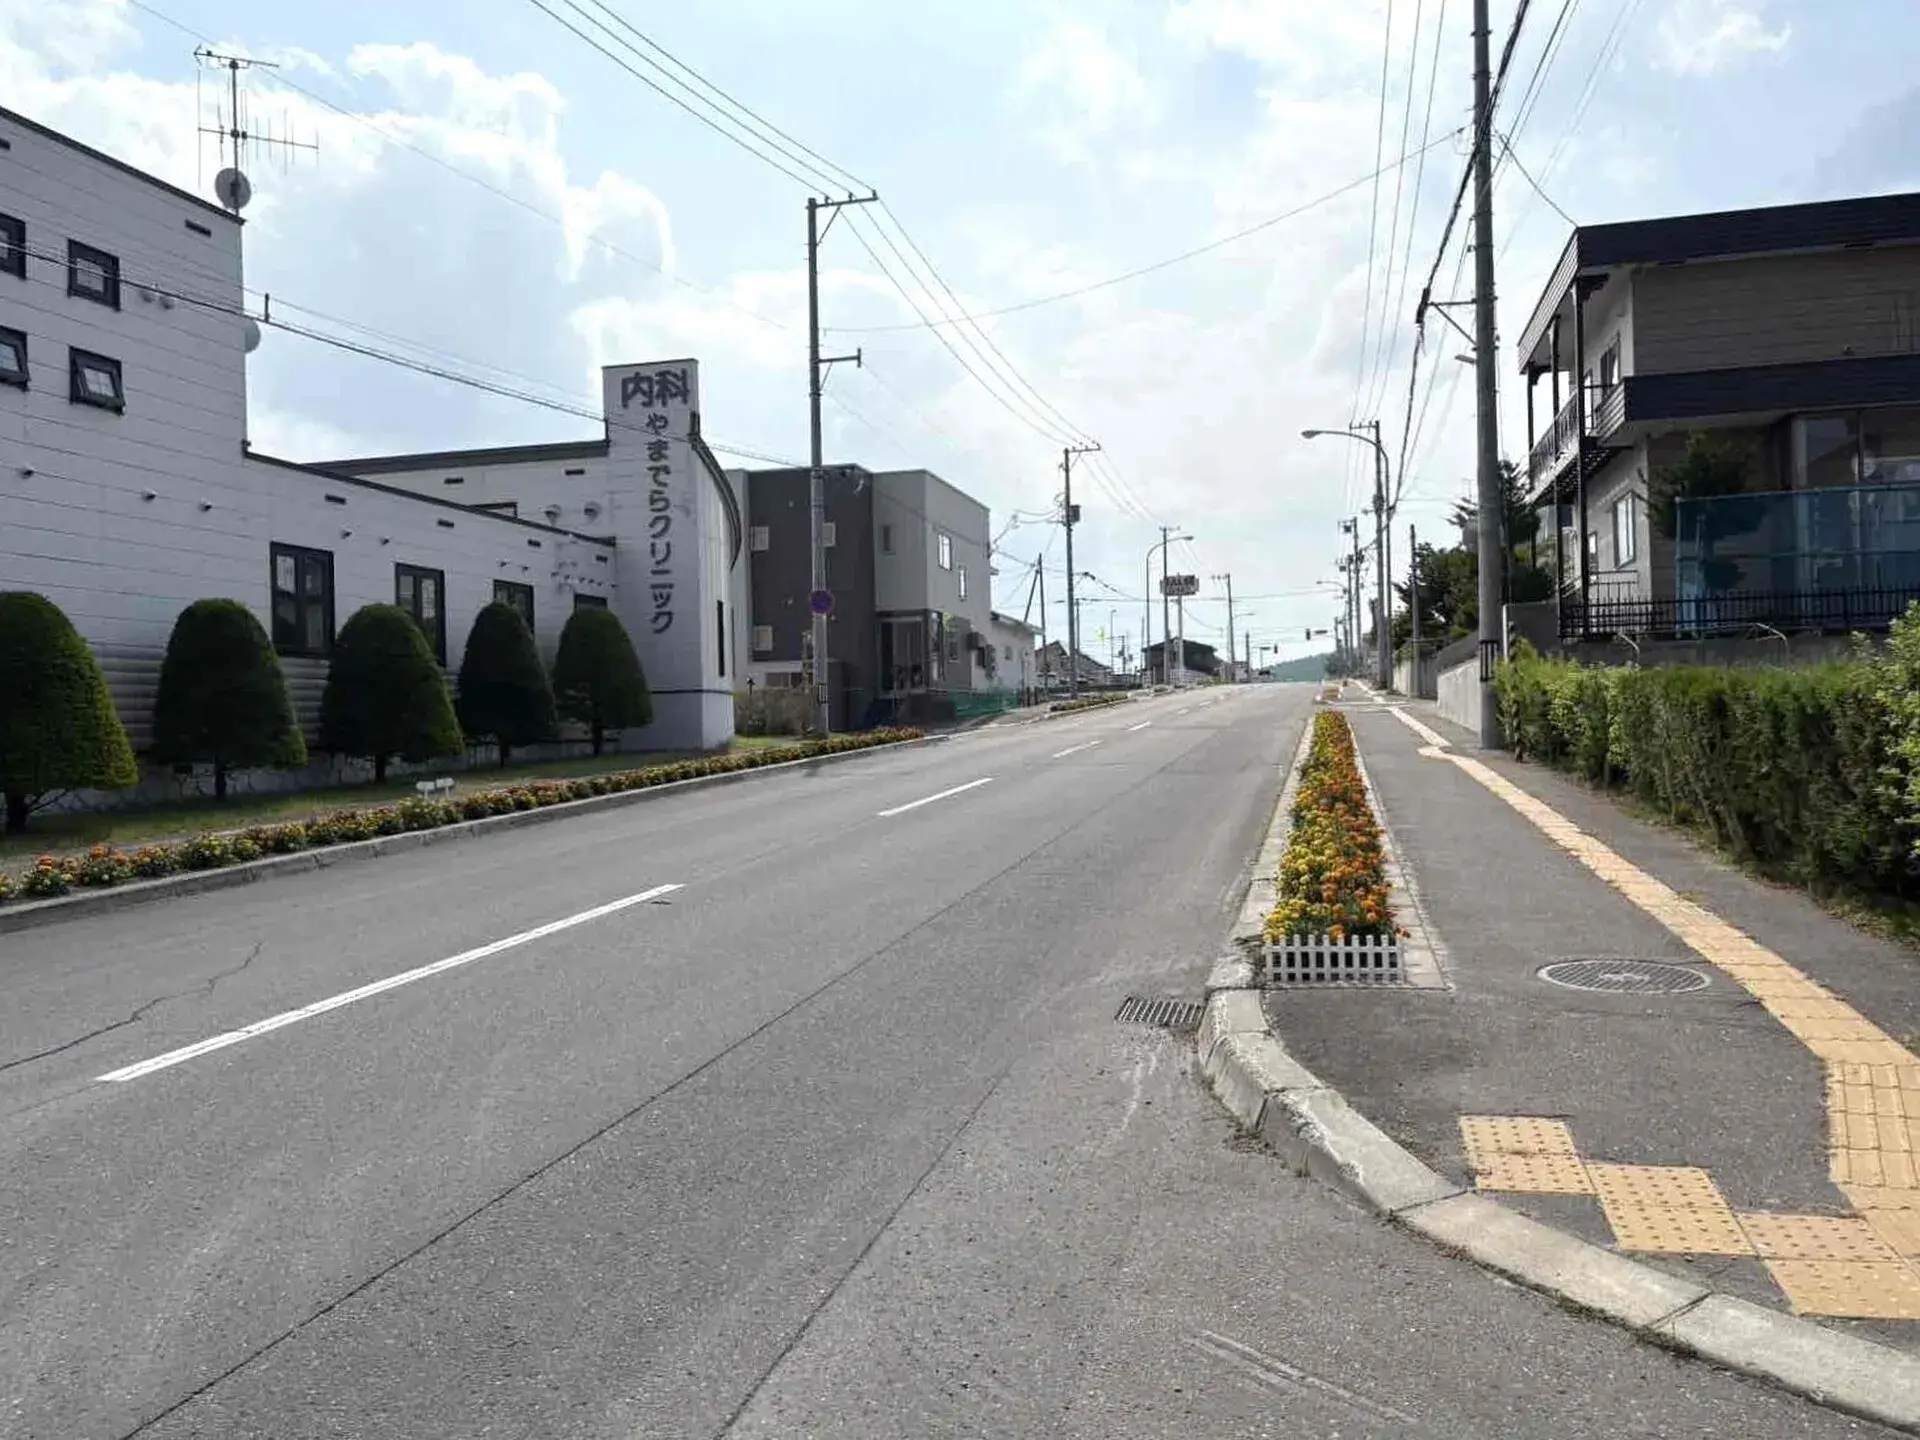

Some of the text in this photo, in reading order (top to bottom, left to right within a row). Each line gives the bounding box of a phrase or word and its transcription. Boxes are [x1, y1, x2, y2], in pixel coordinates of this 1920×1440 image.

[621, 368, 690, 408] 内科
[646, 413, 674, 634] やまでらクリニック
